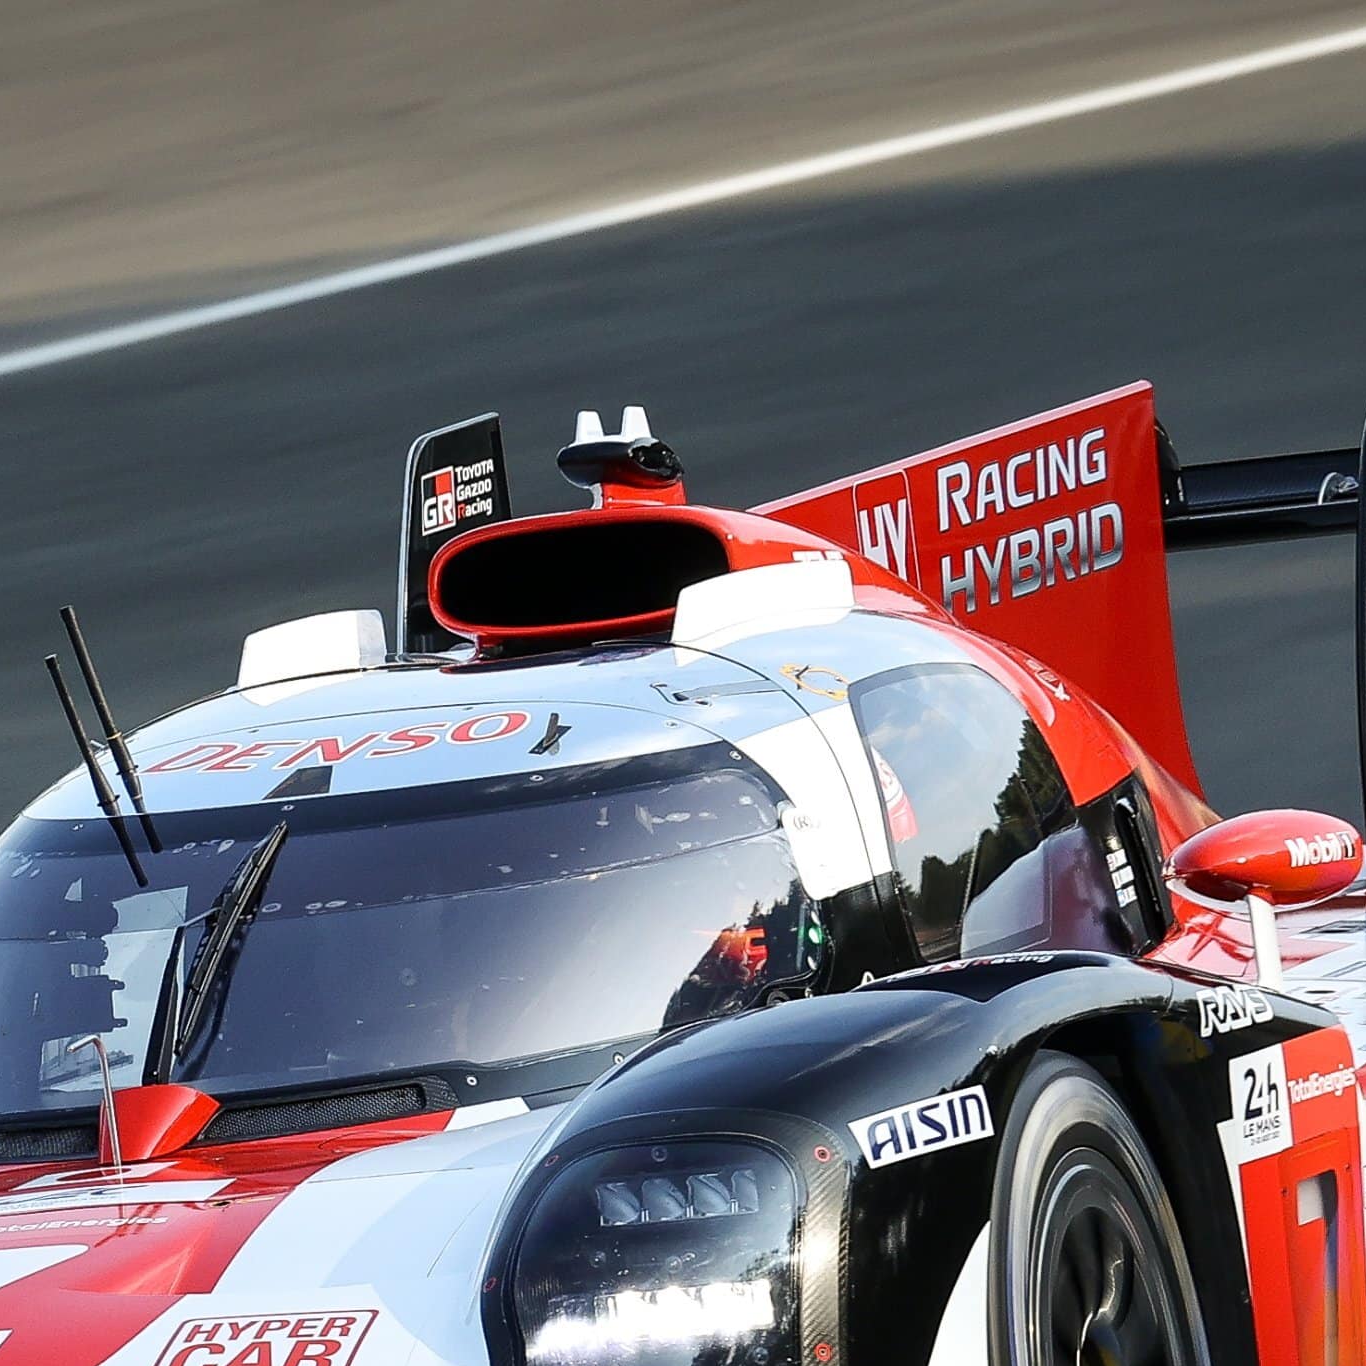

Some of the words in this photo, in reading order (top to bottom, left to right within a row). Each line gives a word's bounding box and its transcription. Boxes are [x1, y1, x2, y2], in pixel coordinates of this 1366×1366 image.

[455, 459, 494, 483] TOYOTA
[456, 479, 492, 501] GAZOO
[937, 428, 1107, 532] RACING
[424, 492, 454, 529] GR
[457, 498, 493, 519] Racing
[859, 499, 908, 581] HY
[941, 502, 1124, 613] HYBRID
[139, 712, 530, 773] DENSO
[1284, 833, 1341, 868] Mobil
[1196, 984, 1275, 1038] RAYS
[1244, 1062, 1280, 1120] 24h
[1288, 1064, 1356, 1104] TotalEnergies
[867, 1093, 986, 1161] AISIN
[183, 1317, 357, 1342] HYPER
